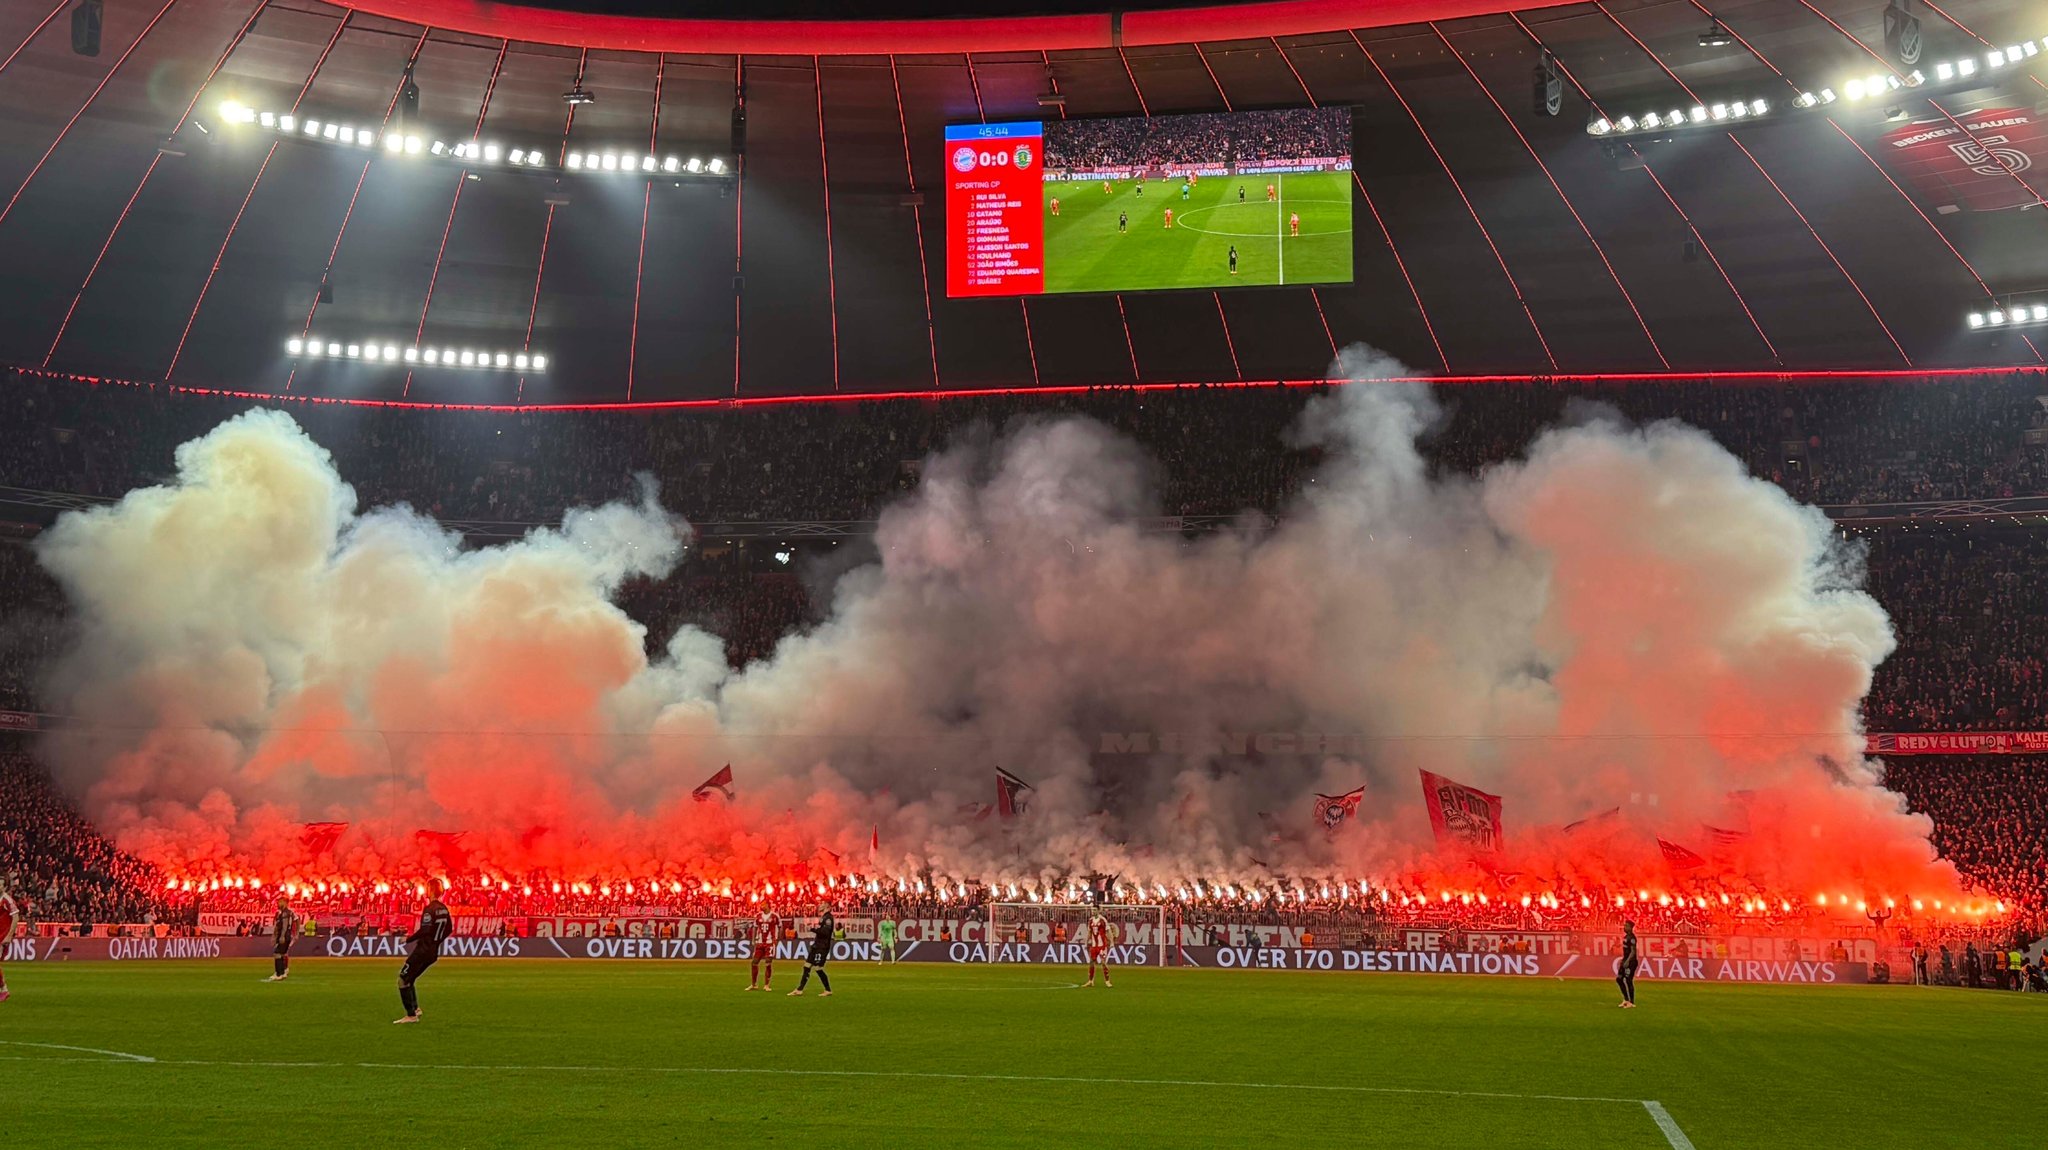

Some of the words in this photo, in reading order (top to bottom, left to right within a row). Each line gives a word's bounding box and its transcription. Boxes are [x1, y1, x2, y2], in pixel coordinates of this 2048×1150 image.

[978, 127, 1009, 137] 45:44
[1966, 117, 2030, 131] BAUER
[979, 151, 1008, 166] 0:0
[1947, 135, 2032, 176] 5
[955, 182, 989, 190] SPORTING
[109, 938, 158, 960] QATAR
[163, 938, 220, 958] AIRWAYS
[327, 936, 408, 957] QATAR
[586, 938, 653, 958] OVER
[661, 939, 697, 958] 170
[1217, 948, 1287, 968] OVER
[1294, 949, 1334, 969] 170
[1342, 951, 1540, 975] DESTINATIONS
[1717, 960, 1836, 982] AIRWAYS
